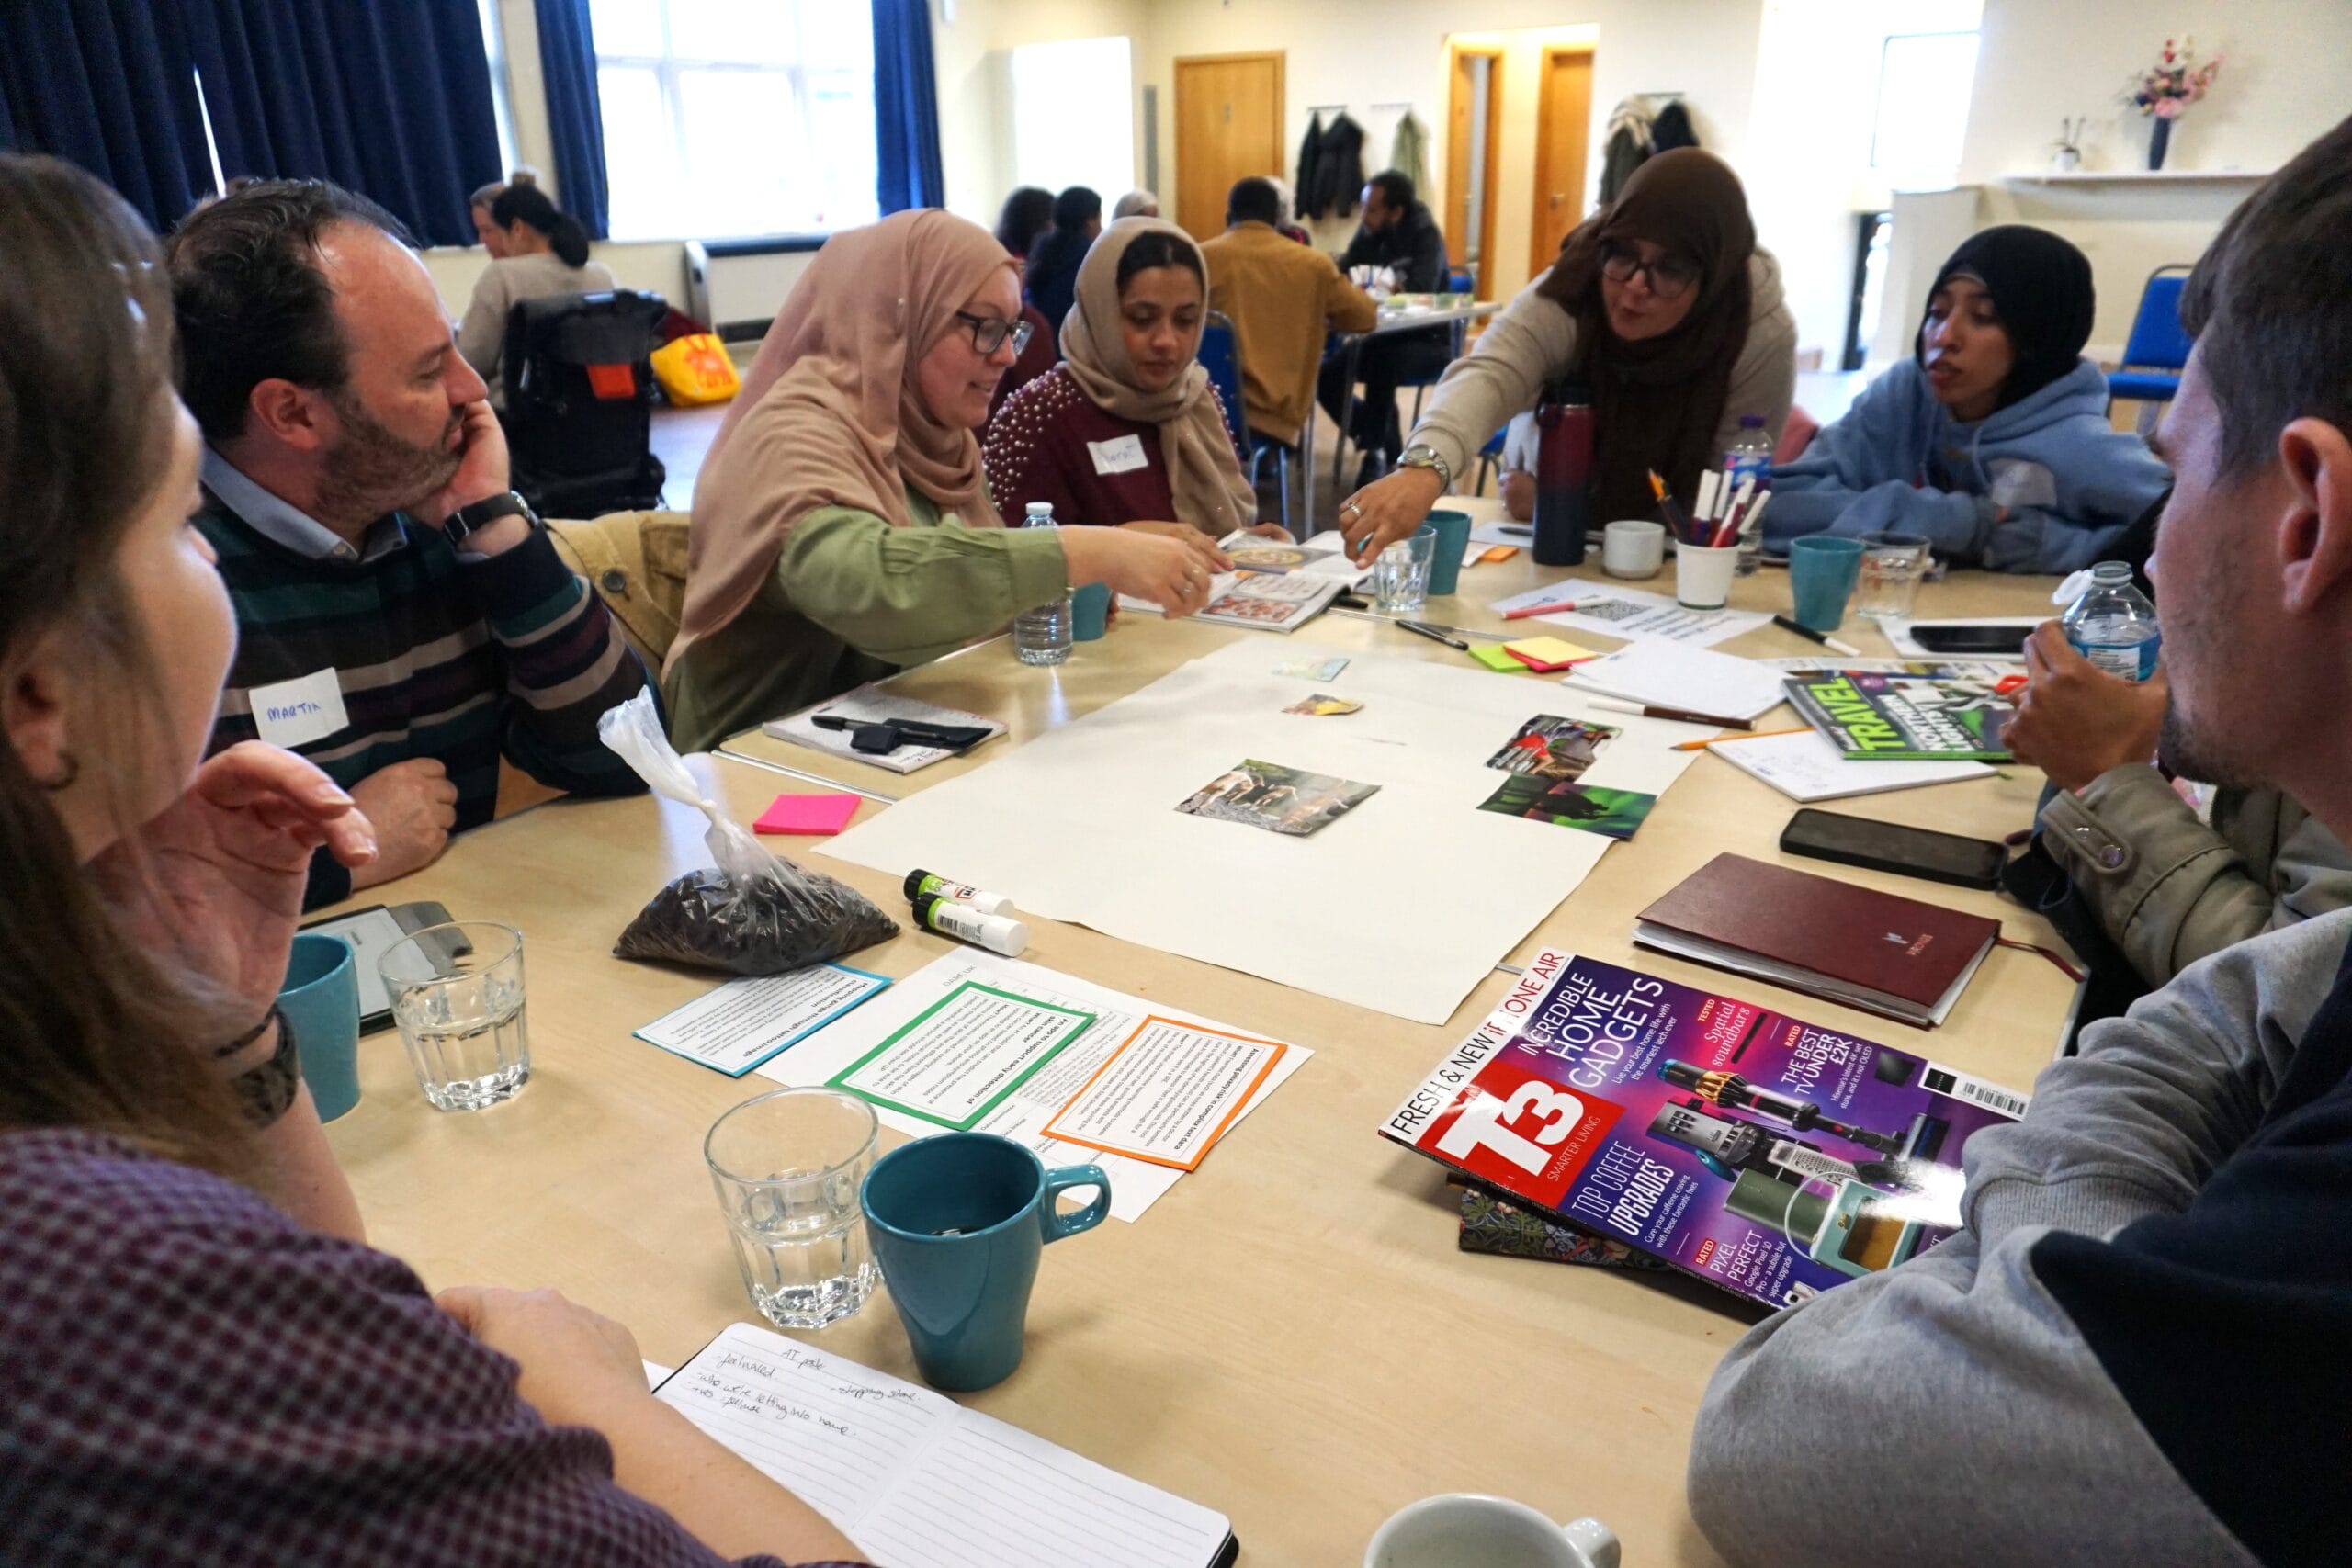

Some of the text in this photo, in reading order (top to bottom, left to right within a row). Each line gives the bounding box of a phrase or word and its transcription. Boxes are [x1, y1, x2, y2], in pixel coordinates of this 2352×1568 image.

[1809, 677, 1906, 751] TRAVEL
[1533, 953, 1565, 980] AIR
[1020, 1015, 1057, 1043] skin cancer
[1518, 972, 1593, 1056] INCREDIBLE
[1546, 987, 1621, 1062] HOME
[1698, 998, 1715, 1021] TESTED
[1704, 1001, 1736, 1043] Spatial
[1014, 1040, 1044, 1060] support
[1451, 1032, 1496, 1070] NEW
[1569, 977, 1664, 1089] GADGETS
[1611, 1003, 1671, 1084] Live your best home life with
[1630, 1016, 1678, 1081] the smartest tech ever
[1712, 1007, 1750, 1067] soundbars
[1784, 1025, 1801, 1047] RATED
[1829, 1037, 1853, 1066] £2K
[999, 1058, 1022, 1073] early
[1234, 1048, 1261, 1072] Assessing
[1439, 1068, 1464, 1084] &
[1781, 1028, 1819, 1084] THE BEST
[1794, 1033, 1838, 1095] TV UNDER
[1860, 1045, 1873, 1065] OLED
[971, 1072, 1007, 1099] detection
[1215, 1089, 1228, 1099] risk
[1220, 1071, 1242, 1089] privacy
[1191, 1104, 1216, 1127] complex
[1391, 1081, 1451, 1134] FRESH
[1435, 1080, 1584, 1177] T3
[1174, 1137, 1191, 1150] data
[1183, 1126, 1199, 1138] text
[1547, 1116, 1601, 1182] SMARTER LIVING
[1572, 1140, 1645, 1219] TOP COFFEE
[1607, 1158, 1675, 1236] UPGRADES
[1644, 1174, 1691, 1243] Cure your caffeine craving
[1657, 1181, 1699, 1248] with these fantastic fixes
[1696, 1240, 1714, 1265] RATED
[1710, 1243, 1737, 1274] PIXEL
[1727, 1229, 1763, 1282] PERFECT
[1745, 1241, 1772, 1287] Google Pixel 10
[1755, 1280, 1767, 1292] Pro
[1775, 1241, 1786, 1253] but
[1769, 1256, 1793, 1298] super upgrade
